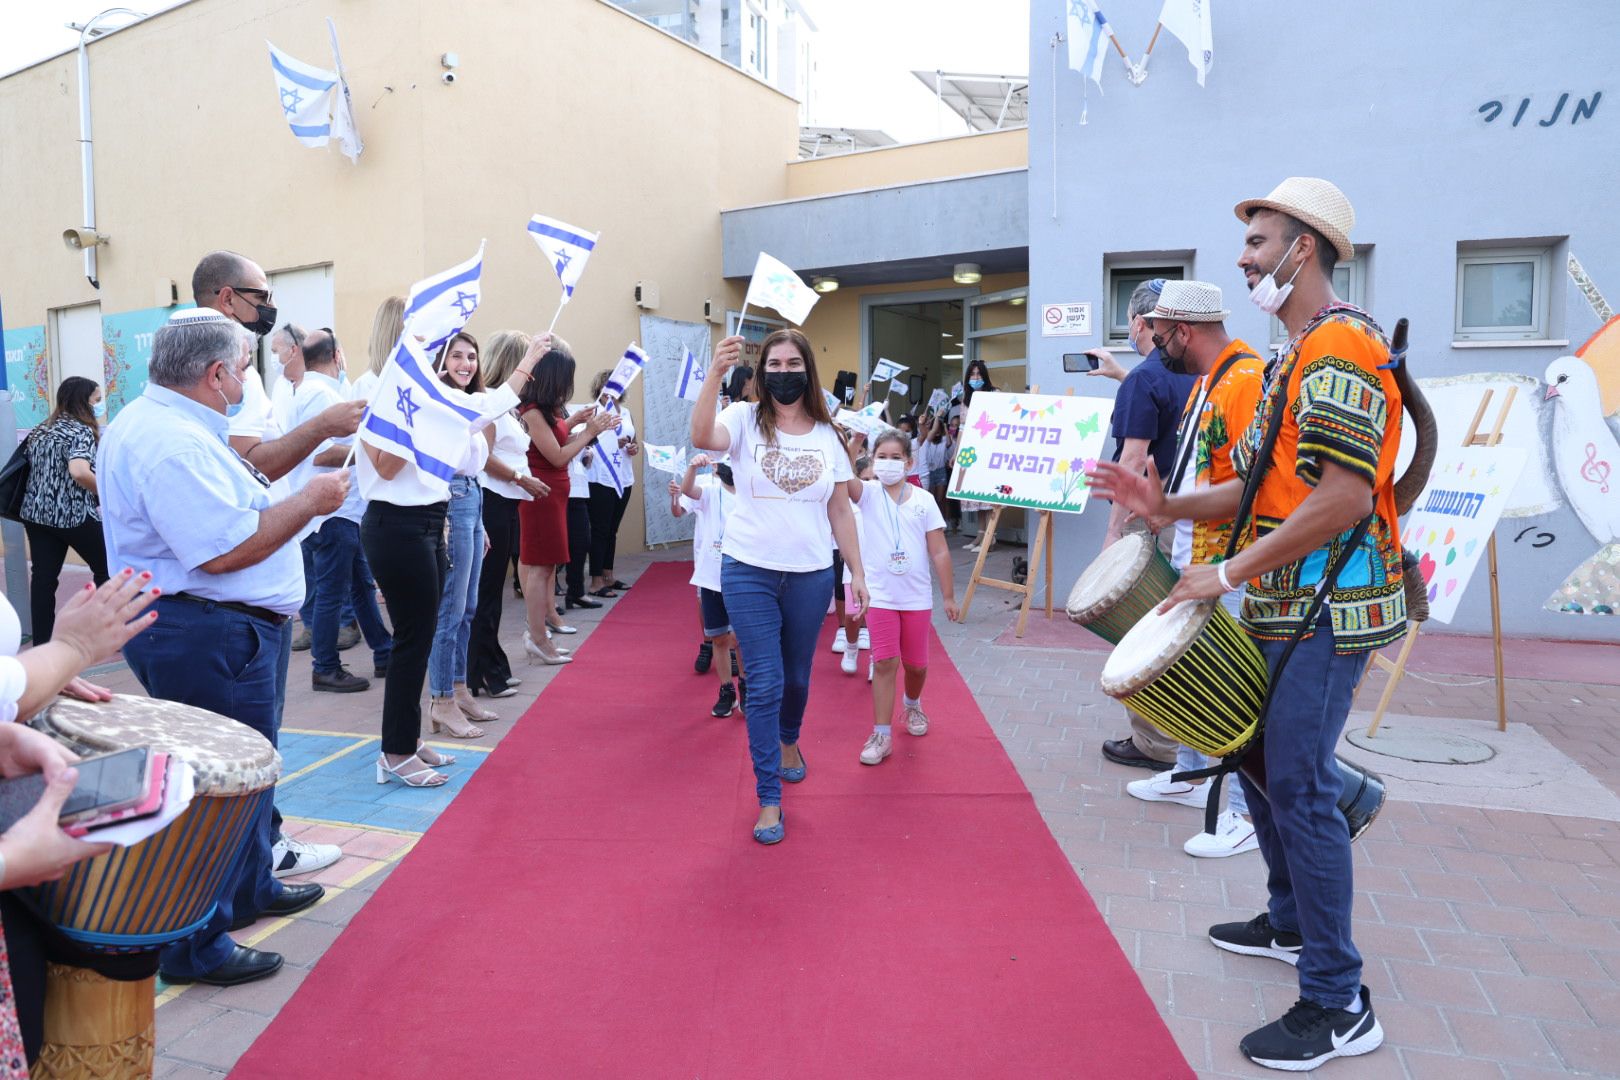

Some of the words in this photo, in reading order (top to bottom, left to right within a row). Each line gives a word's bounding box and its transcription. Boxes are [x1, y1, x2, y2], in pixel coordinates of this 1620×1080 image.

[1066, 314, 1085, 323] לעשן
[996, 423, 1062, 445] ברוכים
[988, 452, 1056, 475] הבאים
